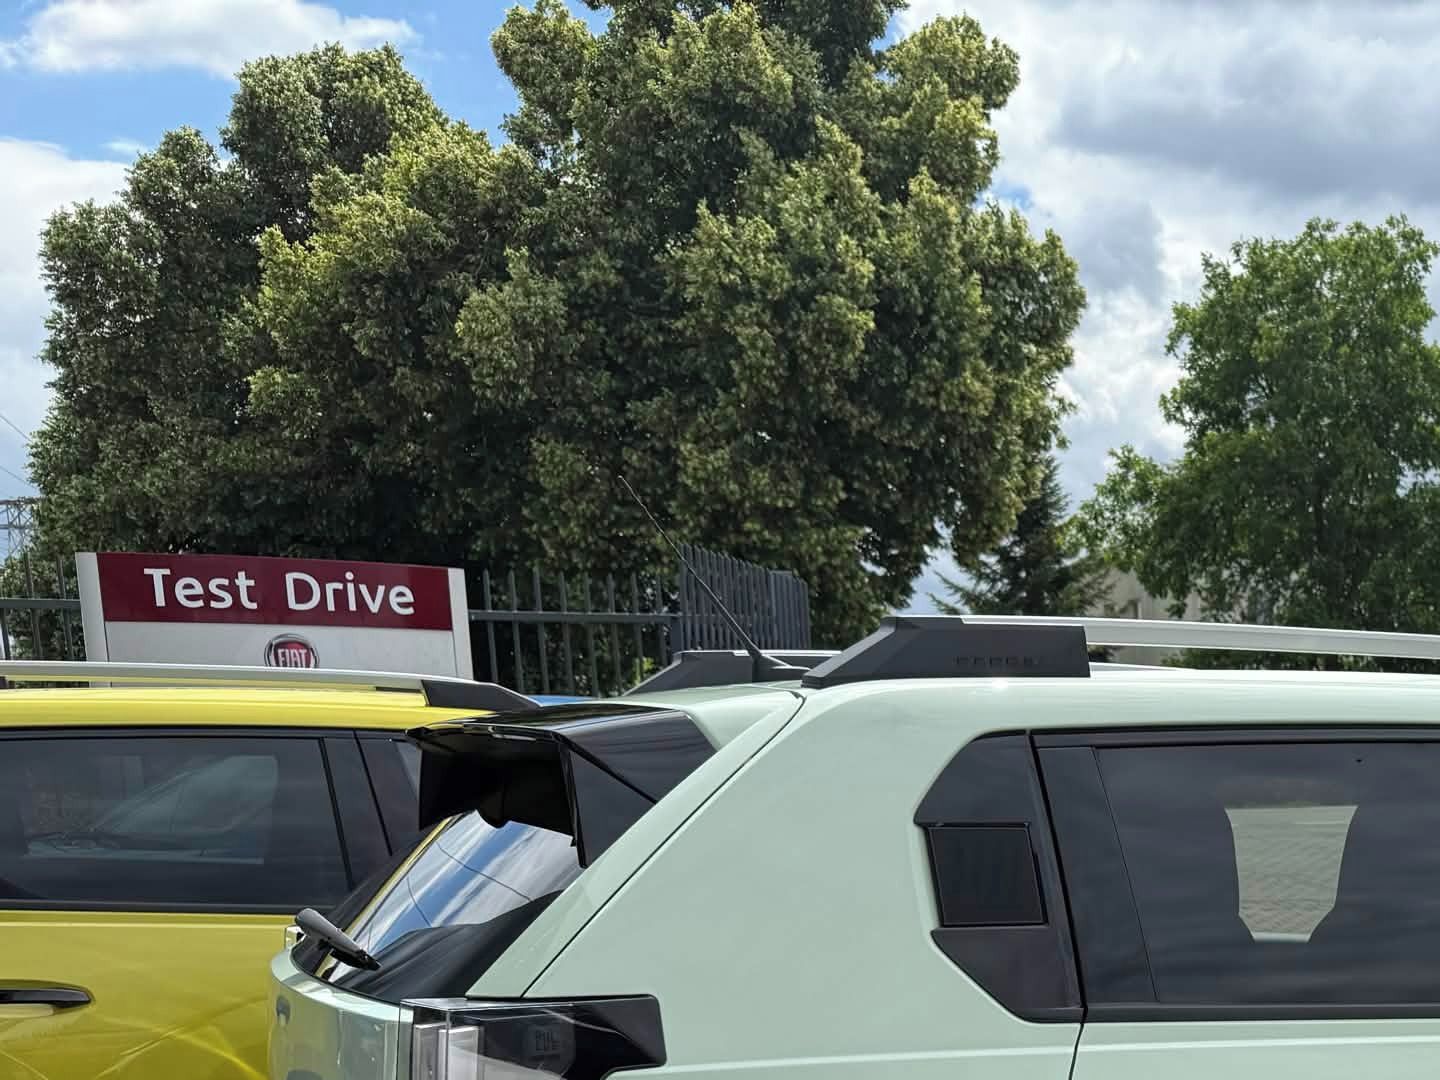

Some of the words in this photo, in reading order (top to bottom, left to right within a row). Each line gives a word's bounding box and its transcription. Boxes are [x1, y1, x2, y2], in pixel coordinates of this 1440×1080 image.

[144, 567, 258, 610] Test
[286, 571, 416, 617] Drive
[277, 648, 308, 668] FIAT
